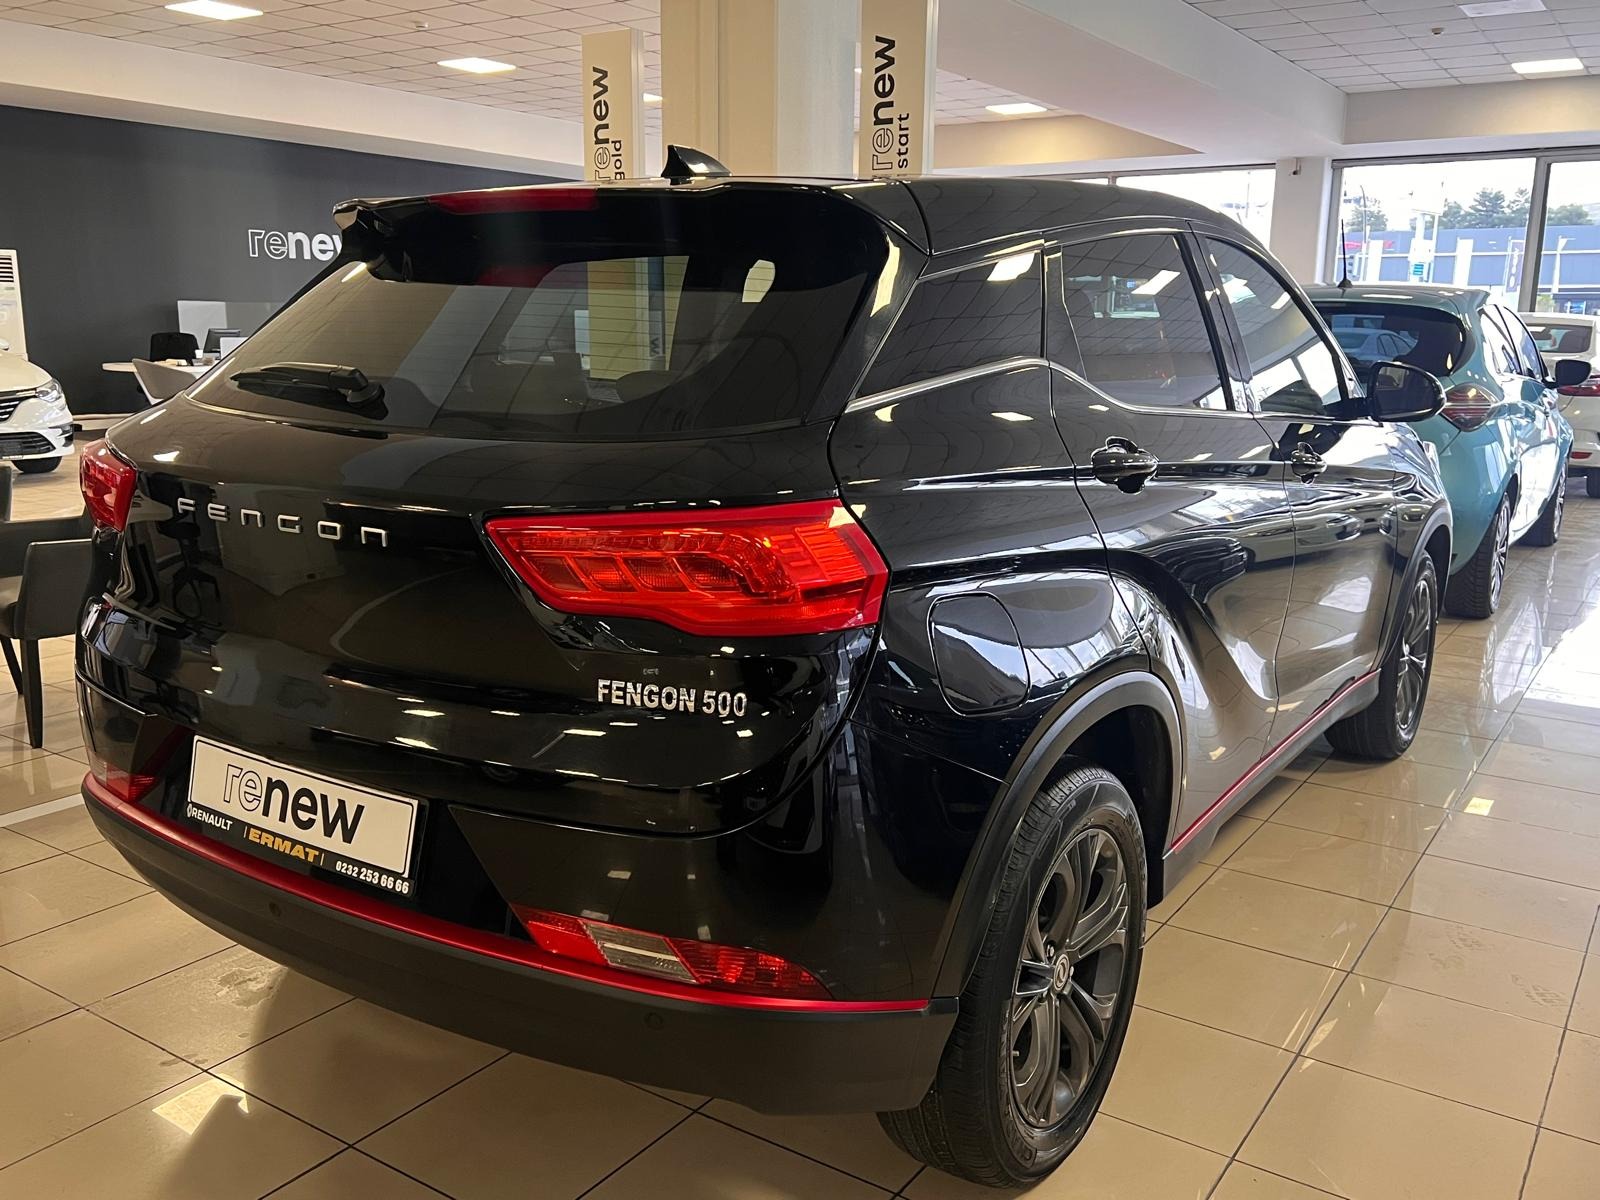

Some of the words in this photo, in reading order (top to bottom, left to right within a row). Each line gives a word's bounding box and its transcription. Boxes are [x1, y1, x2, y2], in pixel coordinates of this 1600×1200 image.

[592, 66, 611, 181] renew
[872, 35, 896, 171] renew
[611, 140, 625, 181] gold
[897, 113, 910, 169] start
[597, 678, 697, 713] FENGON
[702, 689, 748, 718] 500
[191, 808, 233, 831] RENAULT
[224, 763, 365, 845] renew
[248, 827, 320, 864] ERMAT
[335, 860, 359, 878] 0232
[359, 866, 379, 885] 253
[380, 873, 395, 890] 66
[395, 879, 410, 895] 66
